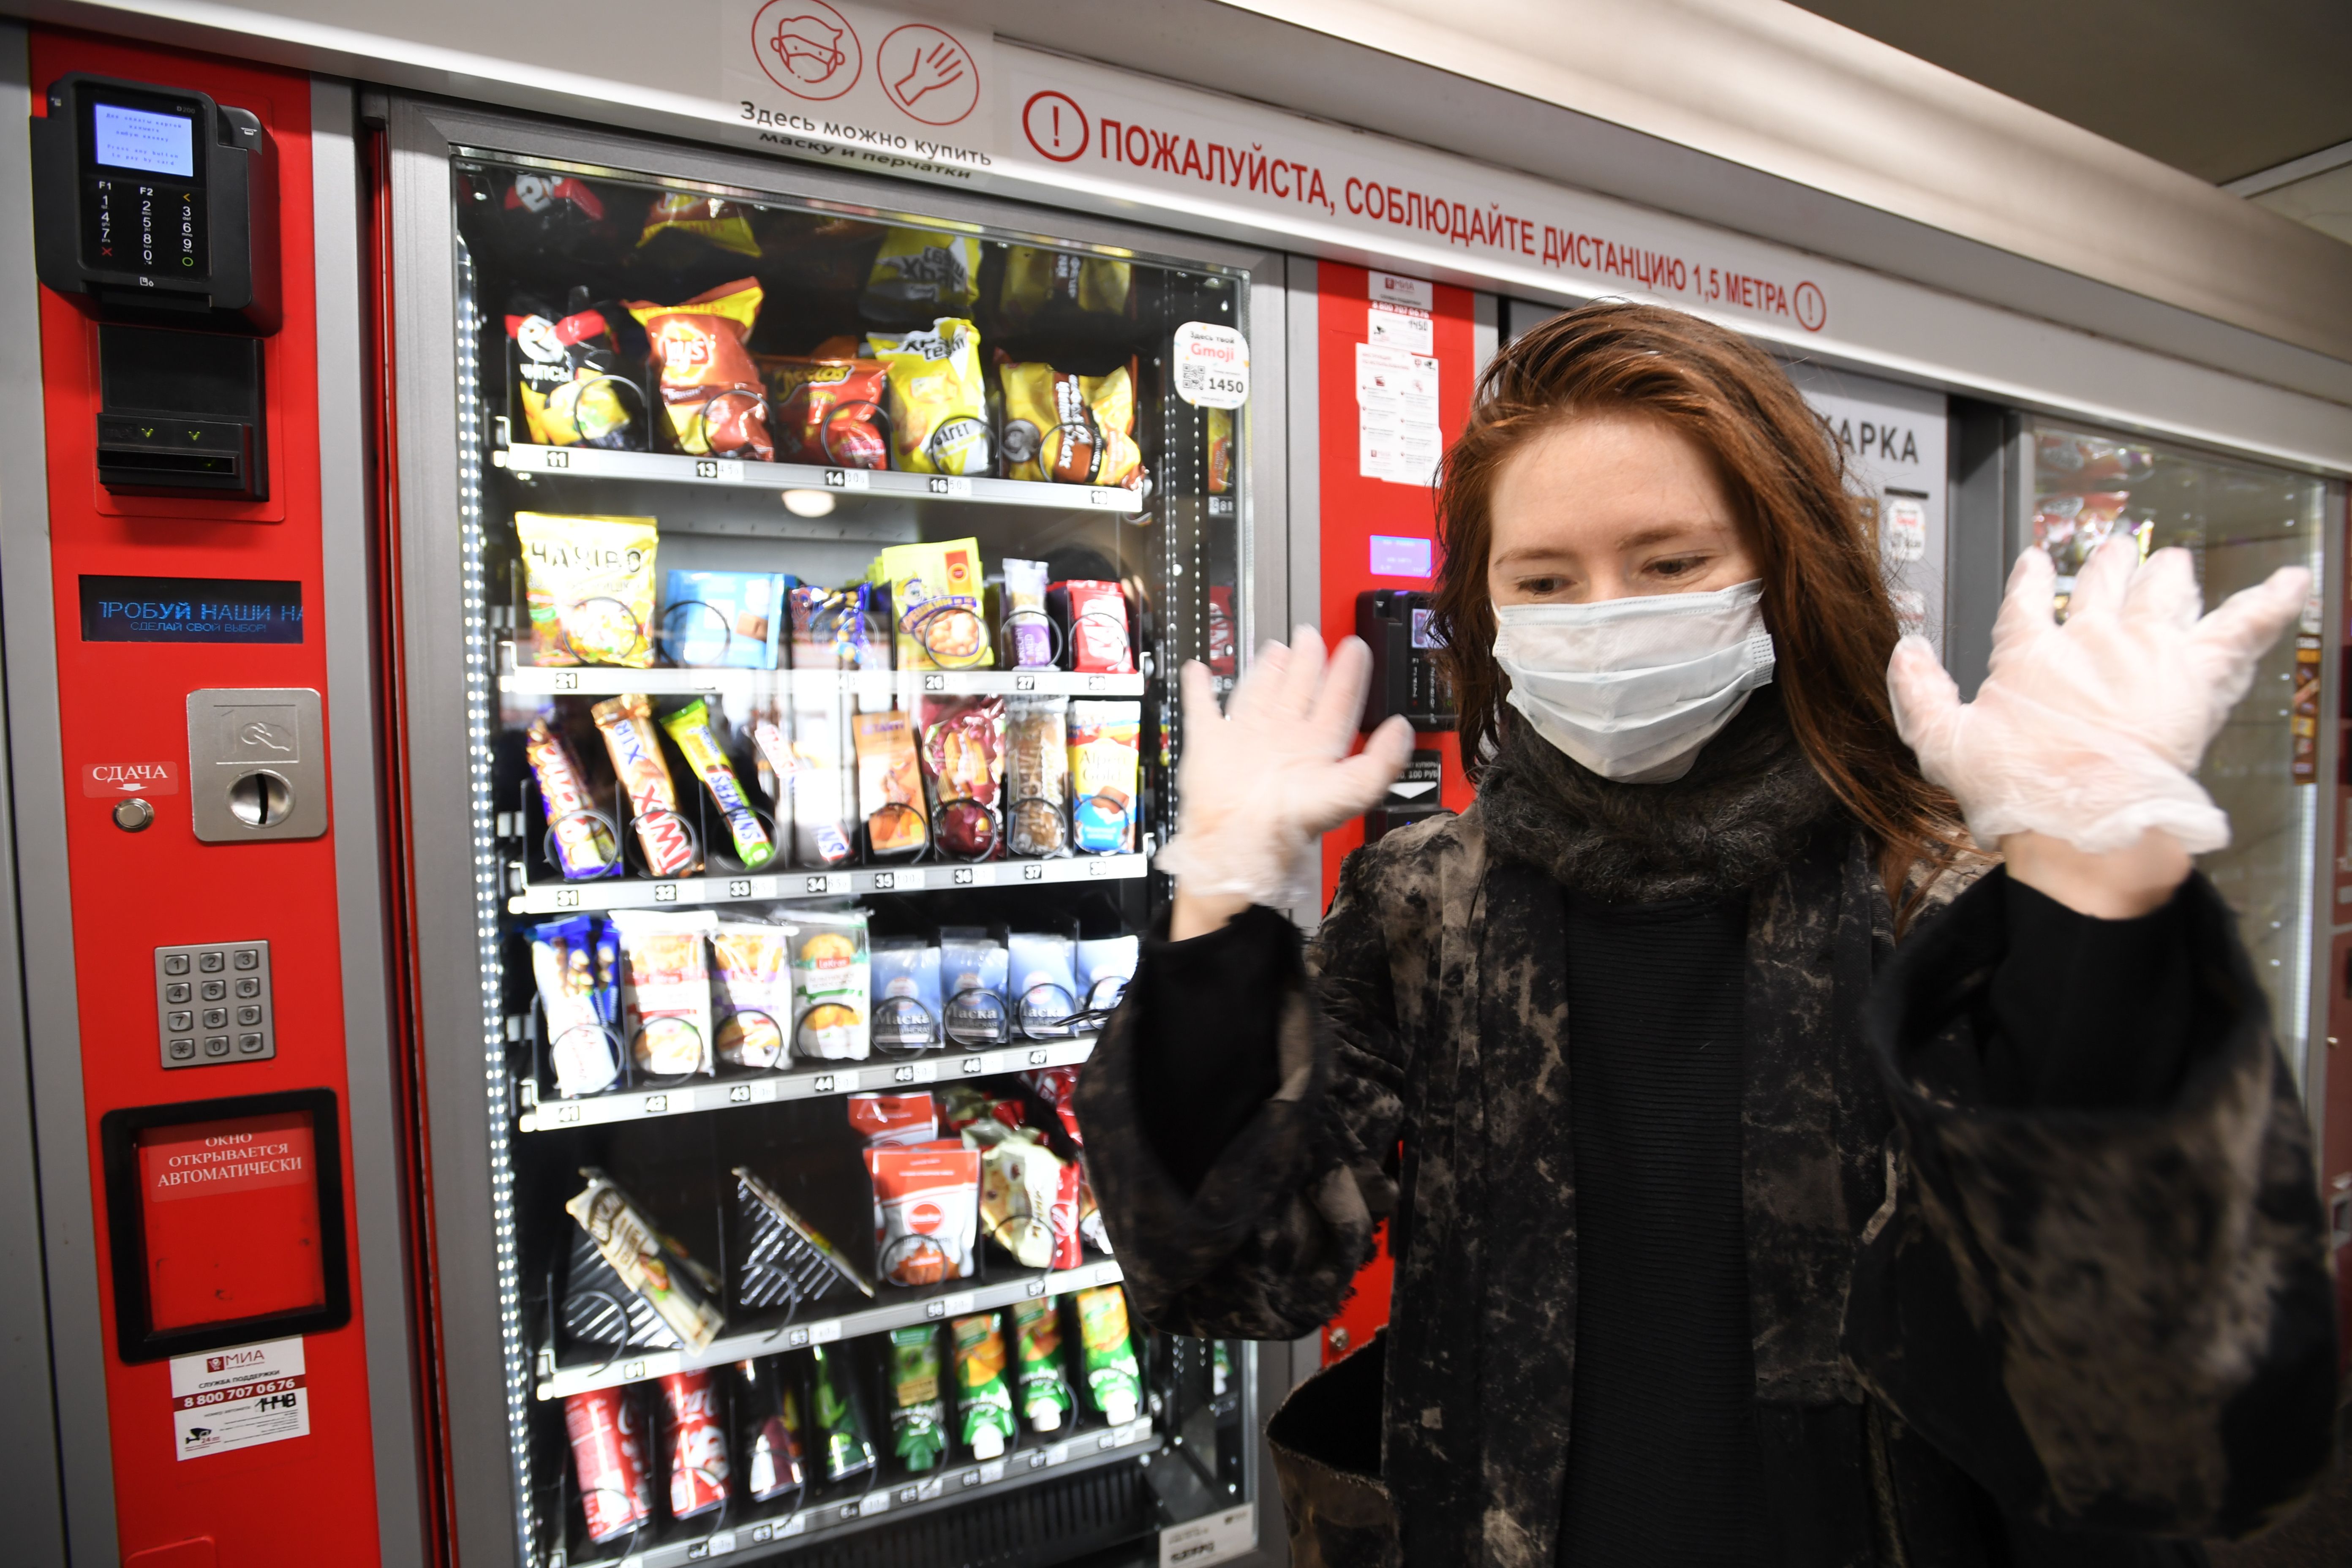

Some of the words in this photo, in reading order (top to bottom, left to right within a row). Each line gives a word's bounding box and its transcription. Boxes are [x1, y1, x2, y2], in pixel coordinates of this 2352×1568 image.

[740, 101, 815, 131] Здесь
[823, 122, 907, 149] можно
[915, 141, 991, 166] купить
[759, 133, 835, 155] маску
[841, 147, 855, 157] и
[862, 153, 971, 179] перчатки
[99, 181, 111, 190] F1
[140, 187, 153, 196] F2
[103, 195, 108, 205] 1
[142, 201, 151, 211] 2
[101, 212, 109, 222] 4
[182, 206, 191, 216] 3
[1100, 118, 1335, 216] ПОЖАЛУЙСТА,
[1345, 177, 1535, 255] СОБЛЮДАЙТЕ
[1542, 226, 1686, 290] ДИСТАНЦИЮ
[1692, 265, 1720, 303] 1,5
[1726, 272, 1788, 316] МЕТРА
[143, 217, 151, 227] 5
[183, 223, 191, 232] 6
[102, 228, 110, 238] 7
[143, 234, 152, 244] 8
[183, 239, 192, 249] 9
[144, 250, 152, 260] 0
[1191, 343, 1234, 362] Gmoji
[1209, 377, 1244, 393] 1450
[1827, 415, 1919, 464] АРКА
[548, 452, 568, 467] 11
[697, 463, 716, 476] 13
[826, 472, 844, 485] 14
[930, 479, 947, 493] 16
[201, 603, 270, 621] НАШИ
[131, 622, 182, 631] СДЕЛАЙ
[186, 623, 221, 632] СВОЙ
[225, 623, 267, 633] ВЫБОР!
[556, 674, 577, 688] 21
[926, 676, 943, 689] 26
[1018, 676, 1034, 689] 27
[92, 764, 169, 783] СДАЧА
[1408, 770, 1422, 779] 100
[955, 869, 972, 882] 36
[1026, 866, 1041, 879] 37
[808, 878, 825, 891] 34
[876, 874, 893, 888] 35
[656, 885, 675, 901] 32
[731, 882, 750, 896] 33
[558, 890, 578, 906] 31
[174, 961, 179, 970] 1
[207, 957, 216, 968] 2
[242, 955, 250, 965] 3
[174, 988, 182, 998] 4
[209, 985, 218, 996] 5
[243, 983, 252, 994] 6
[175, 1016, 184, 1026] 7
[211, 1013, 219, 1024] 8
[245, 1010, 253, 1021] 9
[876, 1011, 930, 1024] Маска
[212, 1041, 220, 1052] 0
[1030, 1050, 1047, 1064] 47
[964, 1059, 981, 1072] 46
[895, 1067, 913, 1080] 45
[815, 1077, 833, 1090] 44
[730, 1087, 750, 1101] 43
[646, 1097, 667, 1111] 42
[559, 1106, 579, 1121] 41
[205, 1132, 253, 1147] ОКНО
[169, 1143, 289, 1167] ОТКРЫВАЕТСЯ
[158, 1157, 302, 1187] АВТОМАТИЧЕСКИ
[226, 1350, 265, 1366] МИА
[199, 1379, 231, 1388] СЛУЖБА
[232, 1370, 280, 1383] ПОДДЕРЖКИ
[184, 1397, 194, 1407] 8
[196, 1392, 224, 1405] 800
[226, 1386, 253, 1399] 707
